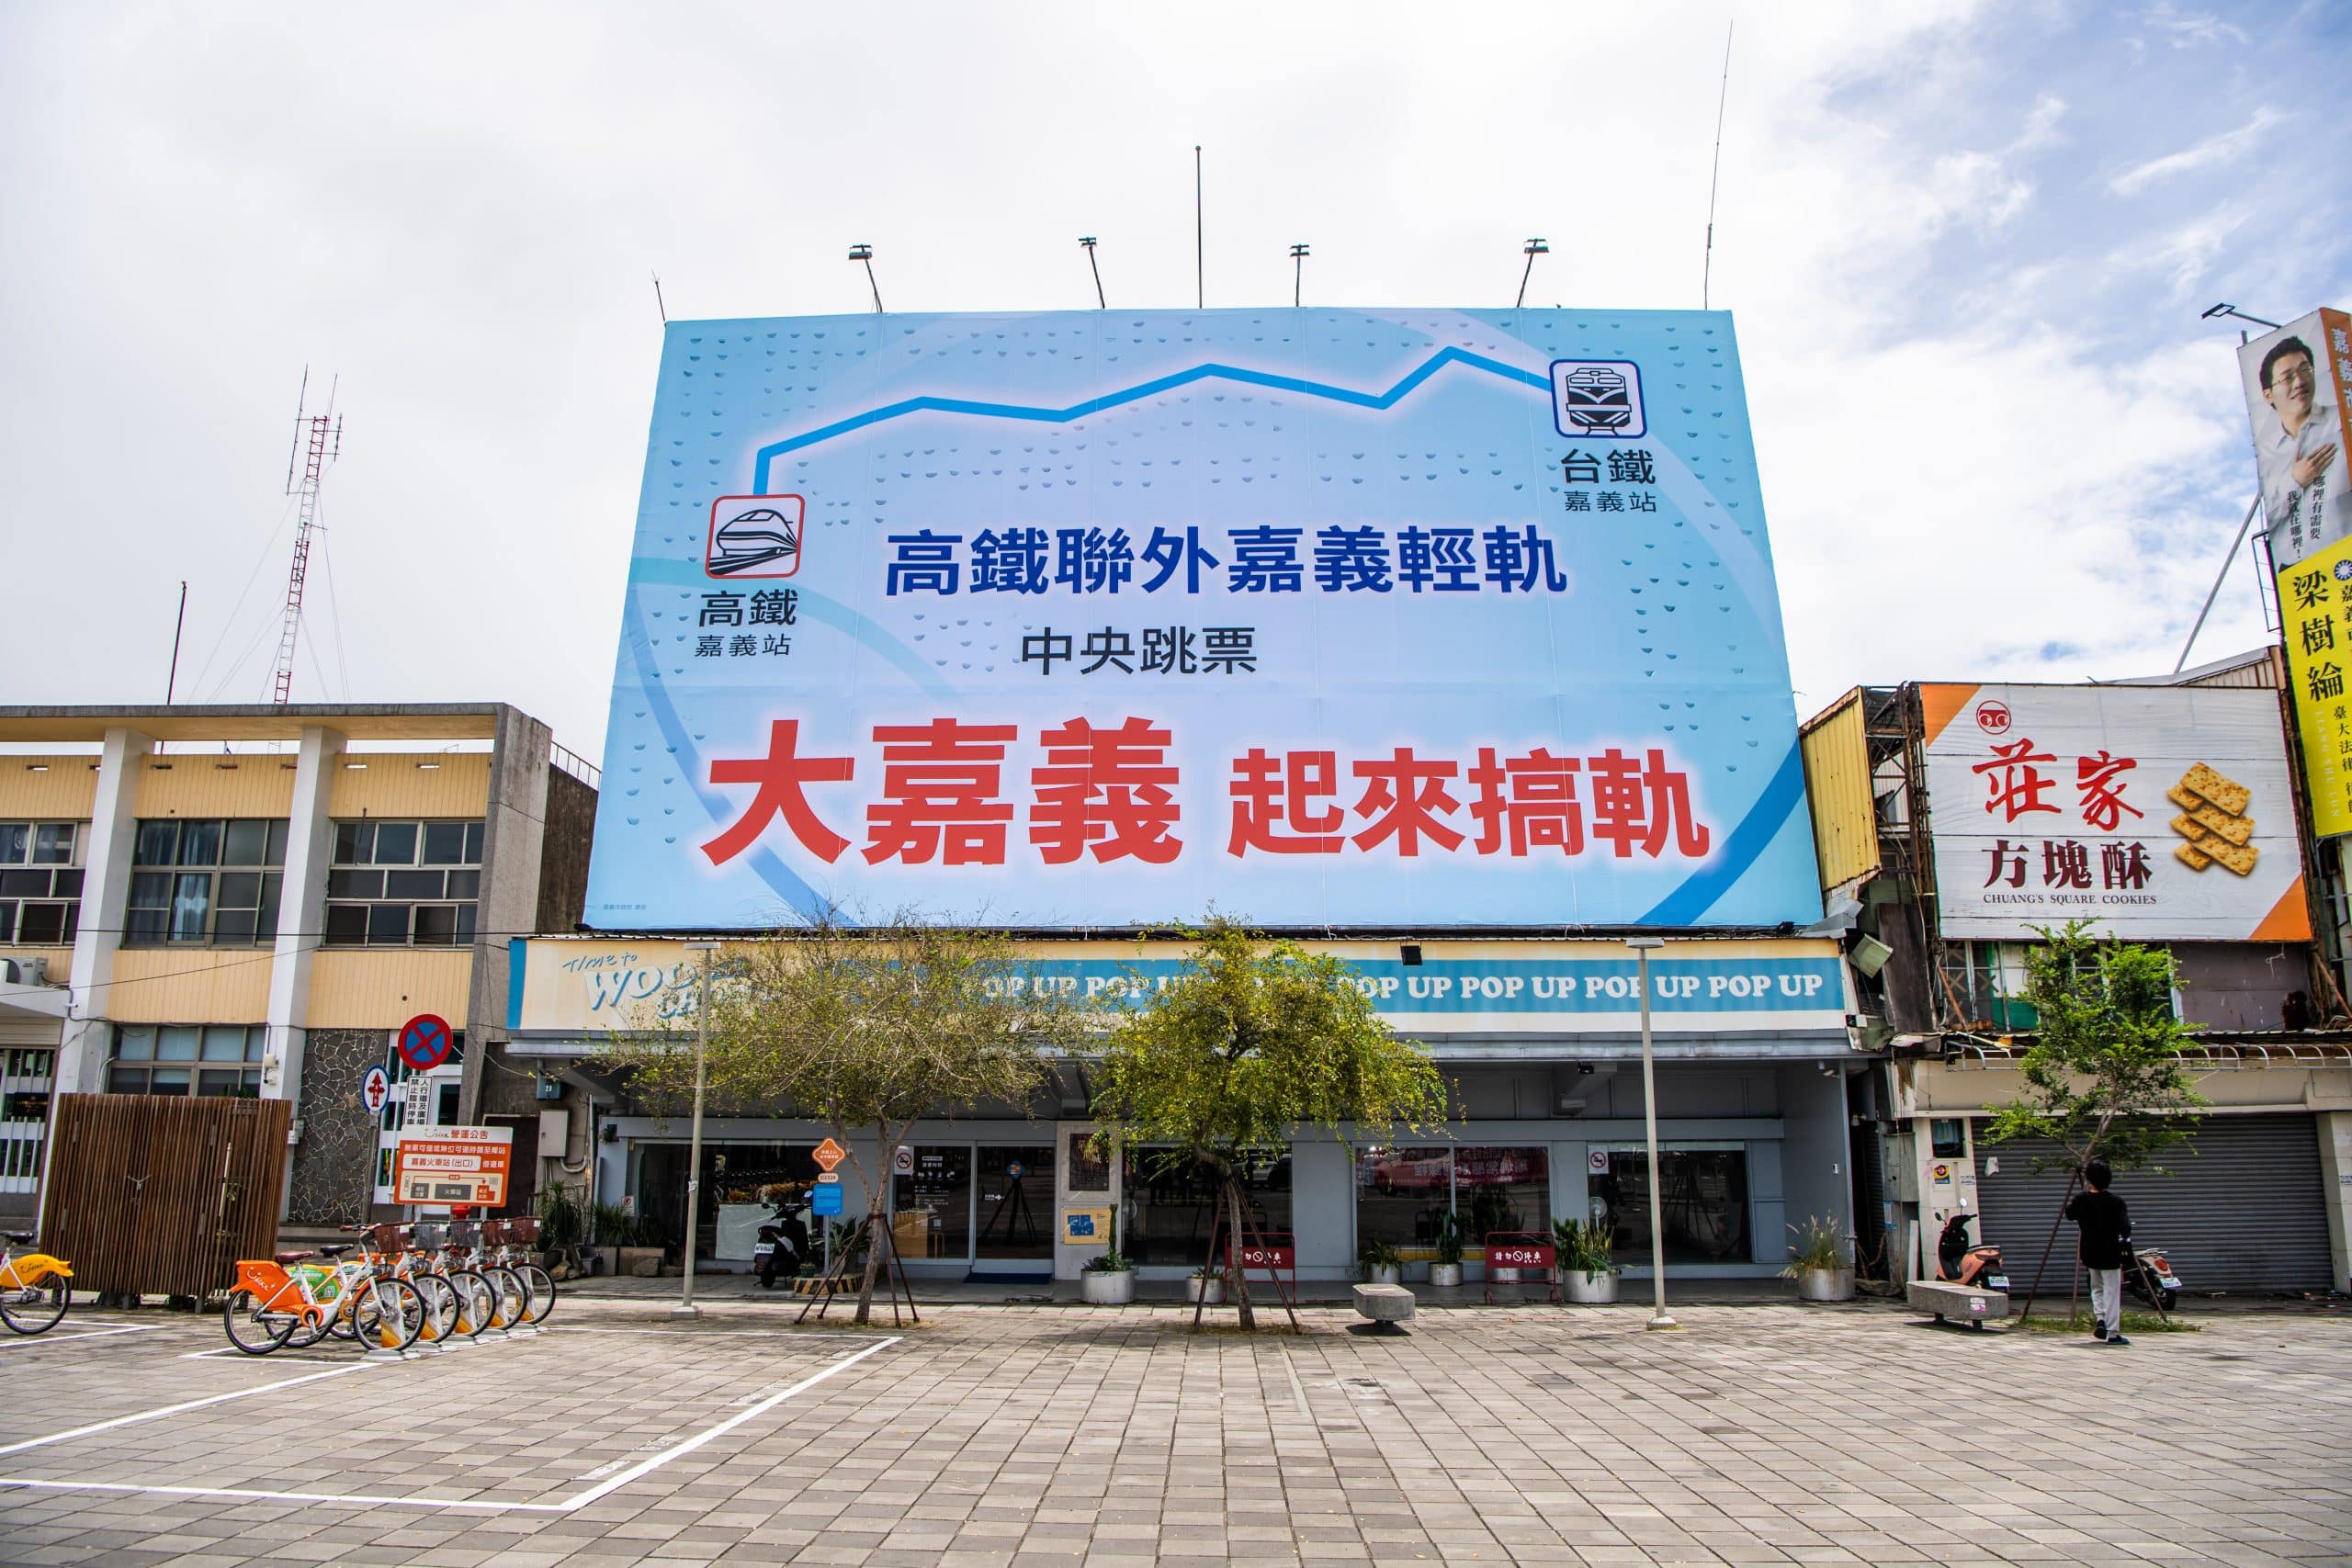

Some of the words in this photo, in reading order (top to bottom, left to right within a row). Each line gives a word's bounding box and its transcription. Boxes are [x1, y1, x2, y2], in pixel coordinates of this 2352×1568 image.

[1561, 448, 1656, 484] 台鐵
[1564, 491, 1657, 513] 嘉義站
[2310, 476, 2325, 540] 哪裡有需要
[886, 525, 1567, 596] 高鐵聯外嘉義輕軌
[699, 589, 798, 626] 高鐵
[695, 634, 791, 657] 嘉義站
[1021, 626, 1257, 676] 中央跳票
[2293, 570, 2344, 702] 梁樹綸
[698, 716, 1184, 866] 大嘉義
[1227, 746, 1711, 860] 起來搞軌
[1972, 738, 2143, 830] 莊家
[1981, 840, 2152, 890] 方塊酥
[1983, 894, 2044, 904] CHUANG'S
[2050, 895, 2097, 906] SQUARE
[2102, 896, 2156, 905] COOKIES
[1034, 976, 1078, 998] UP
[1084, 976, 1148, 998] POP
[1407, 976, 1453, 999] UP
[1460, 976, 1524, 998] POP
[1532, 976, 1577, 998] UP
[1656, 976, 1701, 998] UP
[1707, 975, 1771, 998] POP
[1778, 975, 1823, 998] UP
